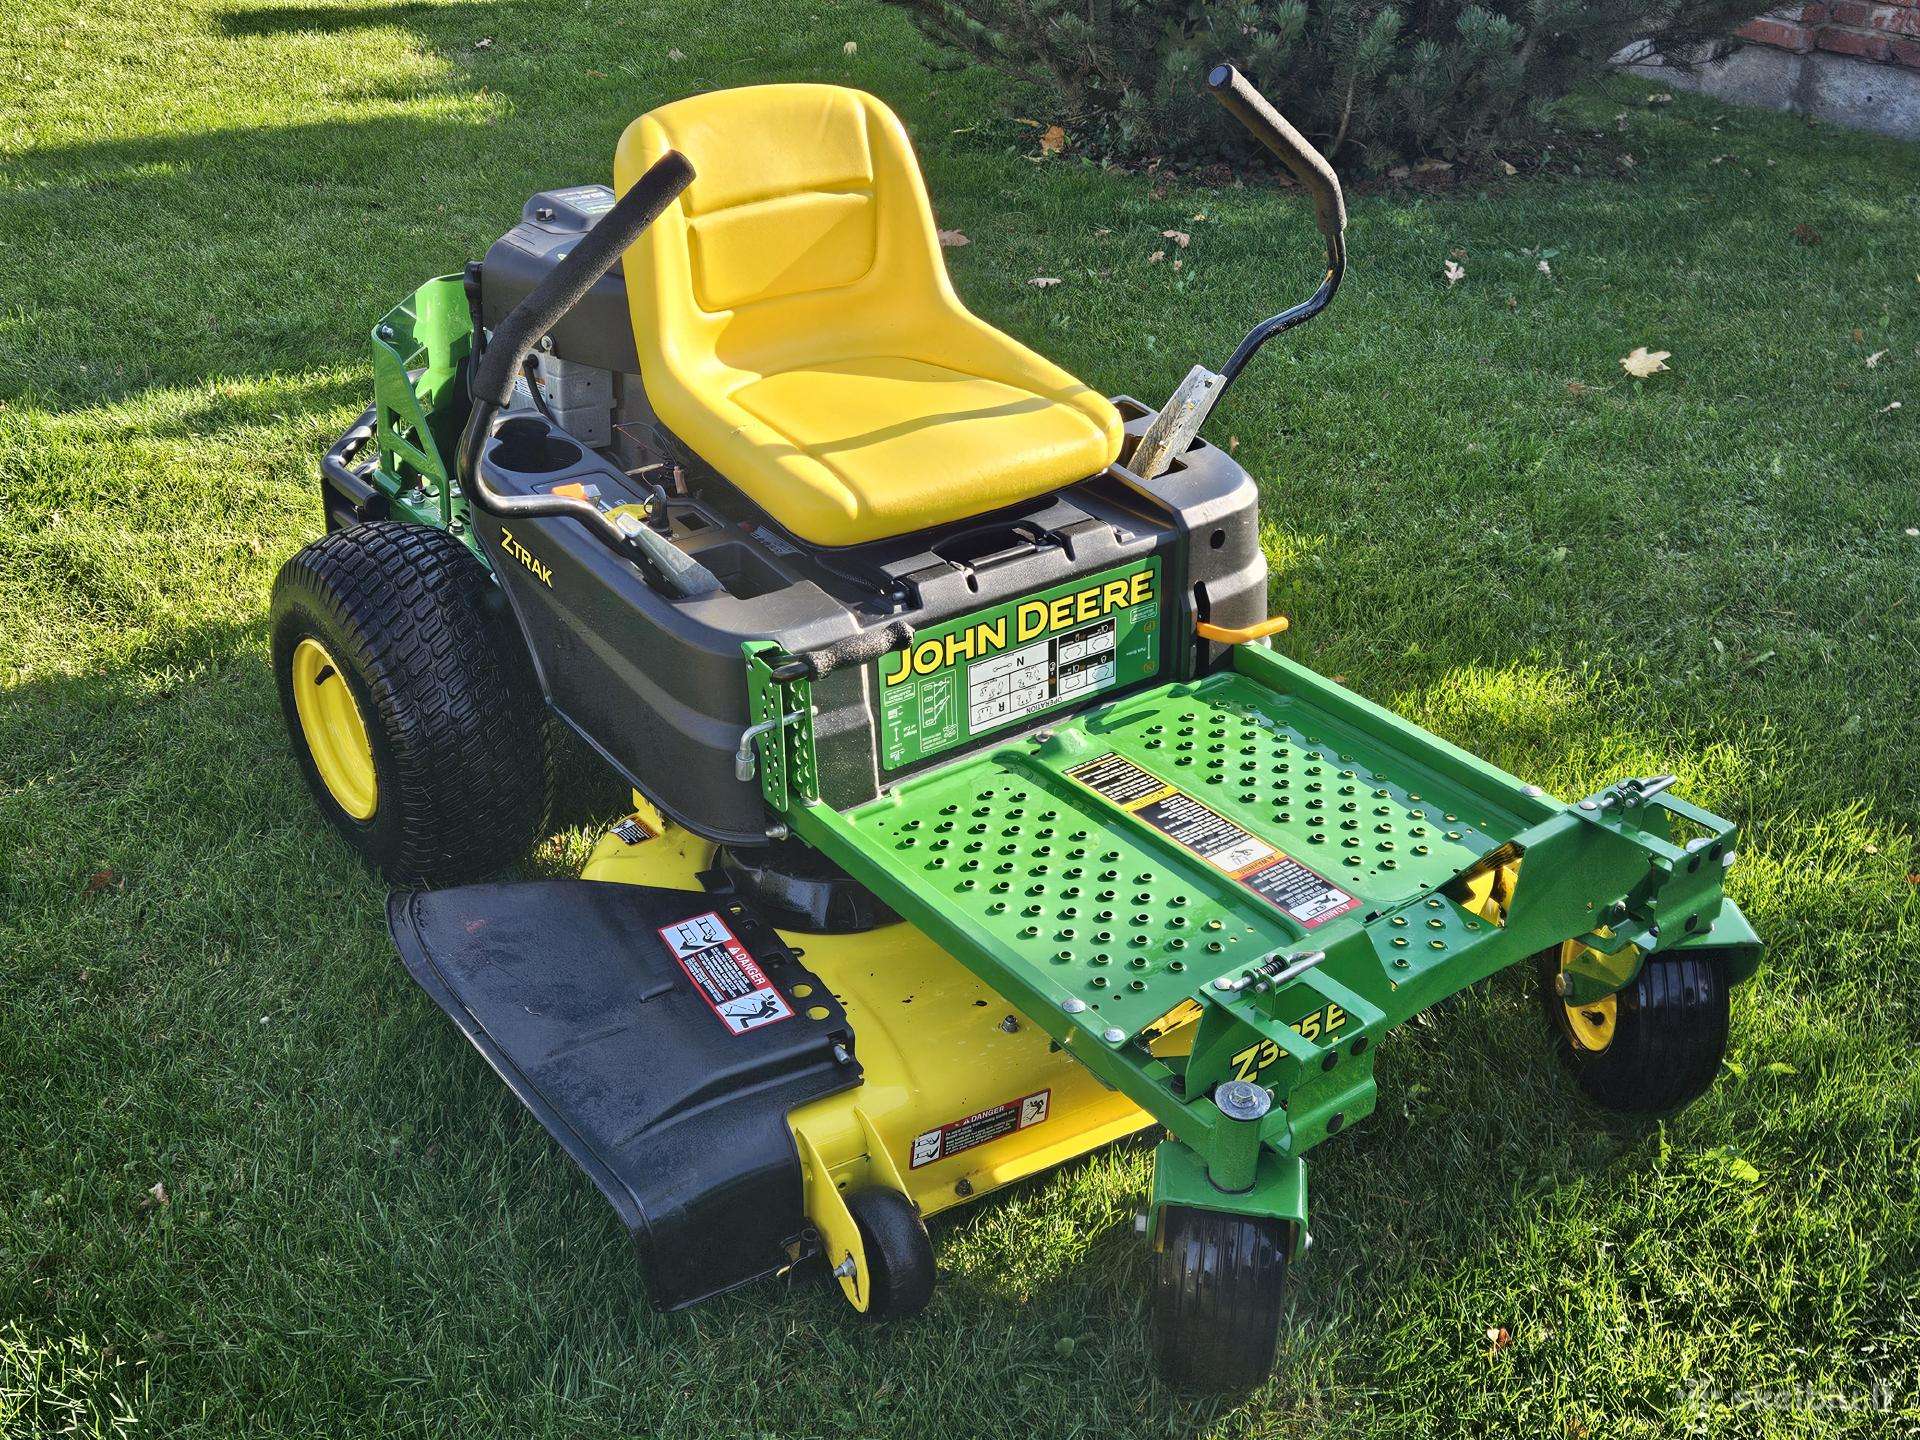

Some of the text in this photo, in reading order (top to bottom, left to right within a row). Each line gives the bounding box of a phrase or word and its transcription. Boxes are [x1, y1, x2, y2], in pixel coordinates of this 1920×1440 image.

[501, 526, 553, 589] ZTRAK
[886, 569, 1155, 687] JOHN DEERE
[1016, 656, 1025, 667] N
[1026, 697, 1063, 714] OPERATION
[736, 953, 766, 986] DANGER
[971, 1106, 1005, 1122] DANGER
